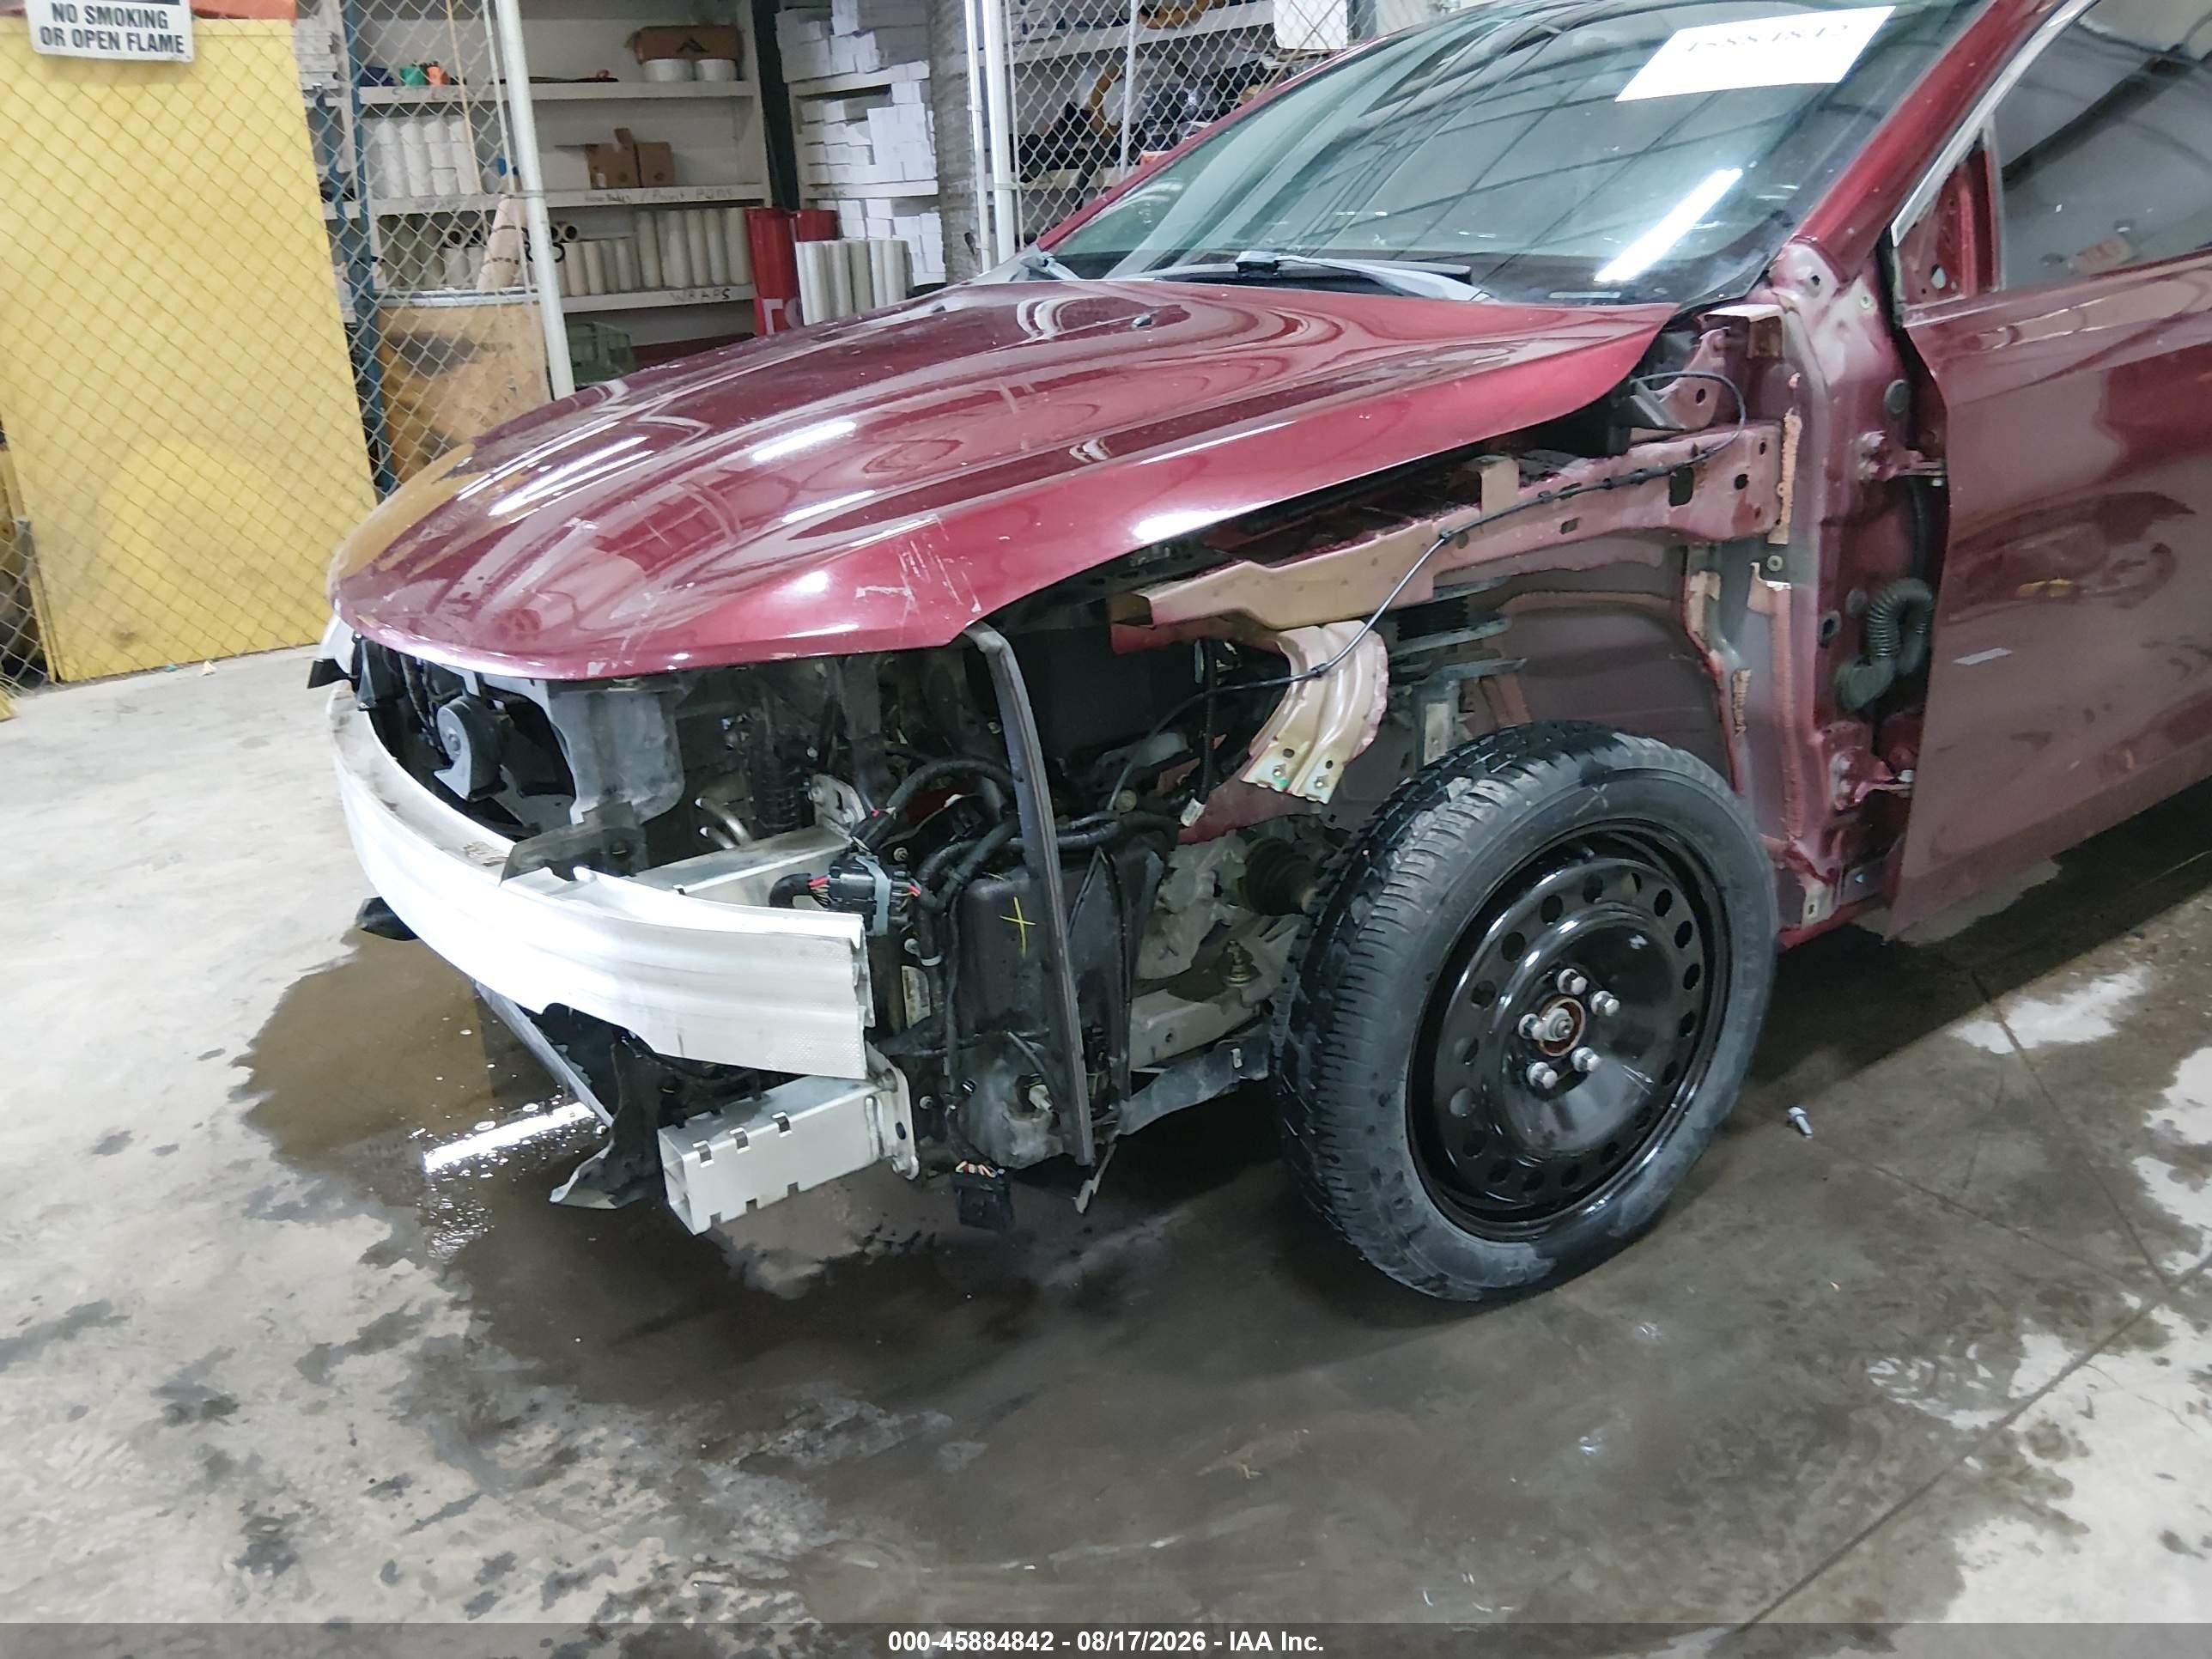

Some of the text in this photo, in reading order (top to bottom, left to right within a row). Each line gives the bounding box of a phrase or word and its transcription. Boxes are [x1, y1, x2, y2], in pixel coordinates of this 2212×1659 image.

[51, 3, 168, 29] NO SMOKING
[40, 26, 185, 54] OR OPEN FLAME
